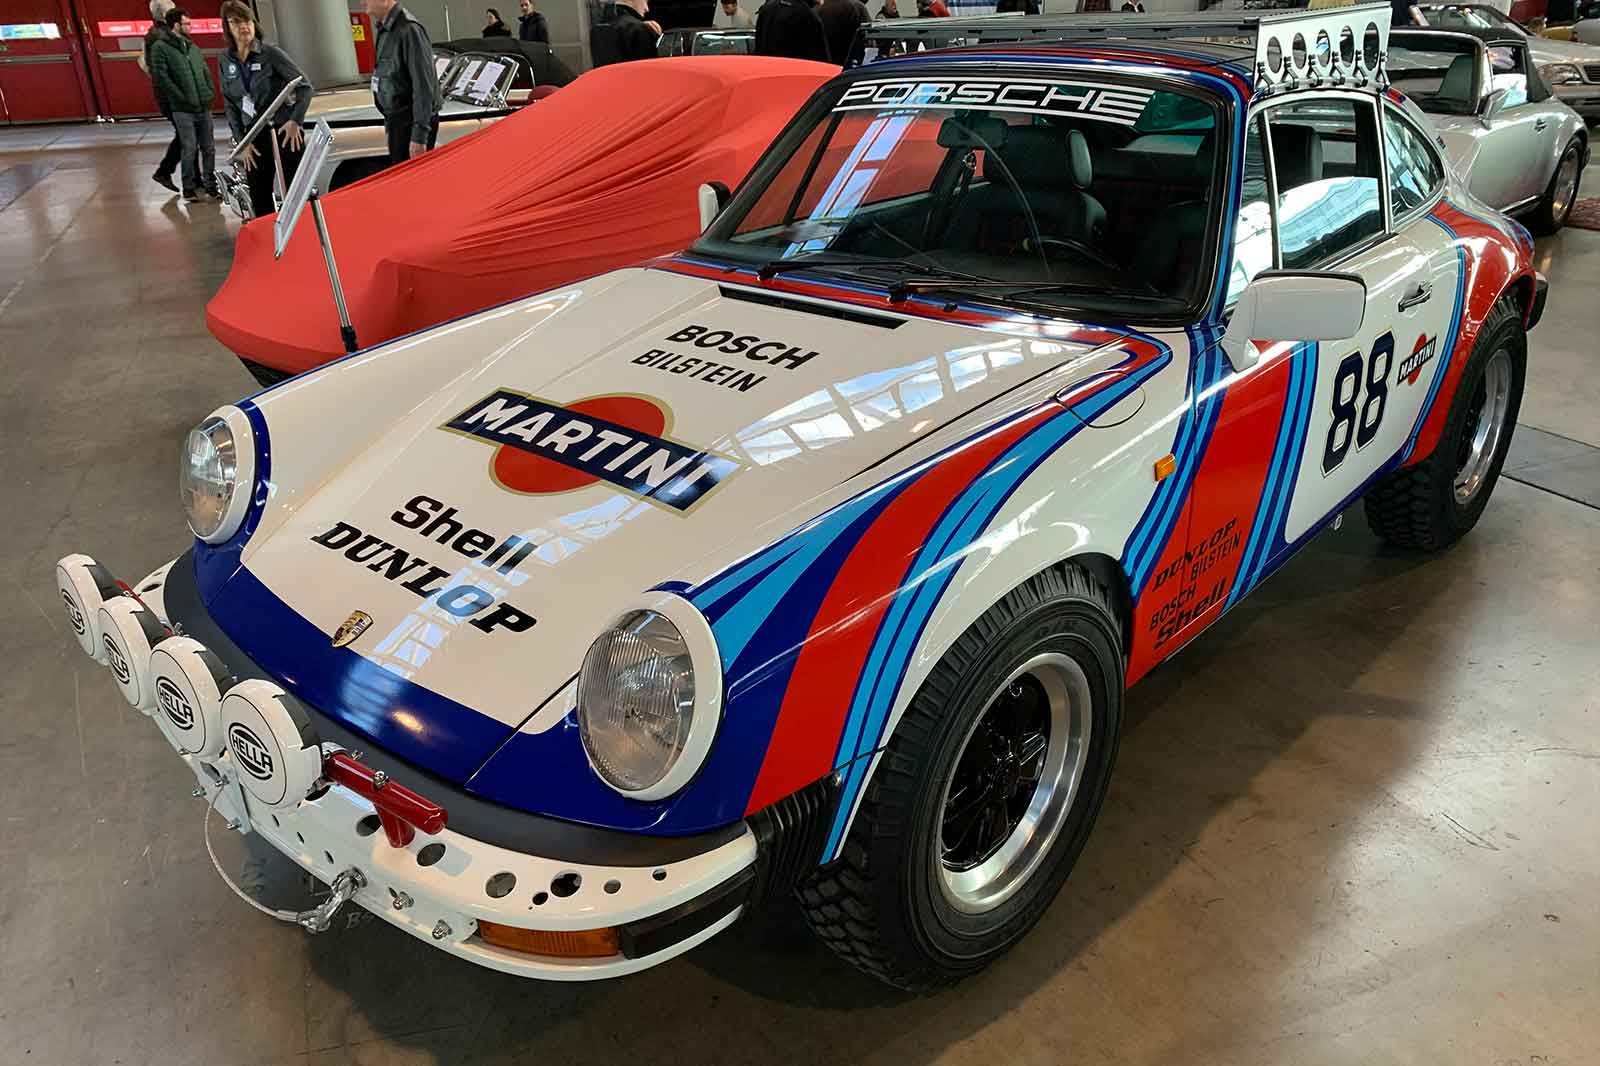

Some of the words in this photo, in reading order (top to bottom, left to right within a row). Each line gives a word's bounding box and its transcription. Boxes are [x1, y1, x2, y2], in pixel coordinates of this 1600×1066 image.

[837, 82, 1150, 117] PORSCHE
[630, 349, 767, 392] BILSTEIN
[665, 325, 819, 370] BOSCH
[1400, 342, 1435, 378] MARTINI
[1321, 329, 1395, 477] 88
[463, 397, 713, 497] MARTINI
[391, 495, 538, 576] Shell
[1152, 518, 1237, 592] DUNLOP
[1190, 531, 1242, 581] BILSTEIN
[310, 521, 537, 634] DUNLOP
[1149, 582, 1197, 632] BOSCH
[1154, 577, 1227, 649] Shell
[159, 686, 194, 723] HELLA
[231, 734, 273, 773] HELLA
